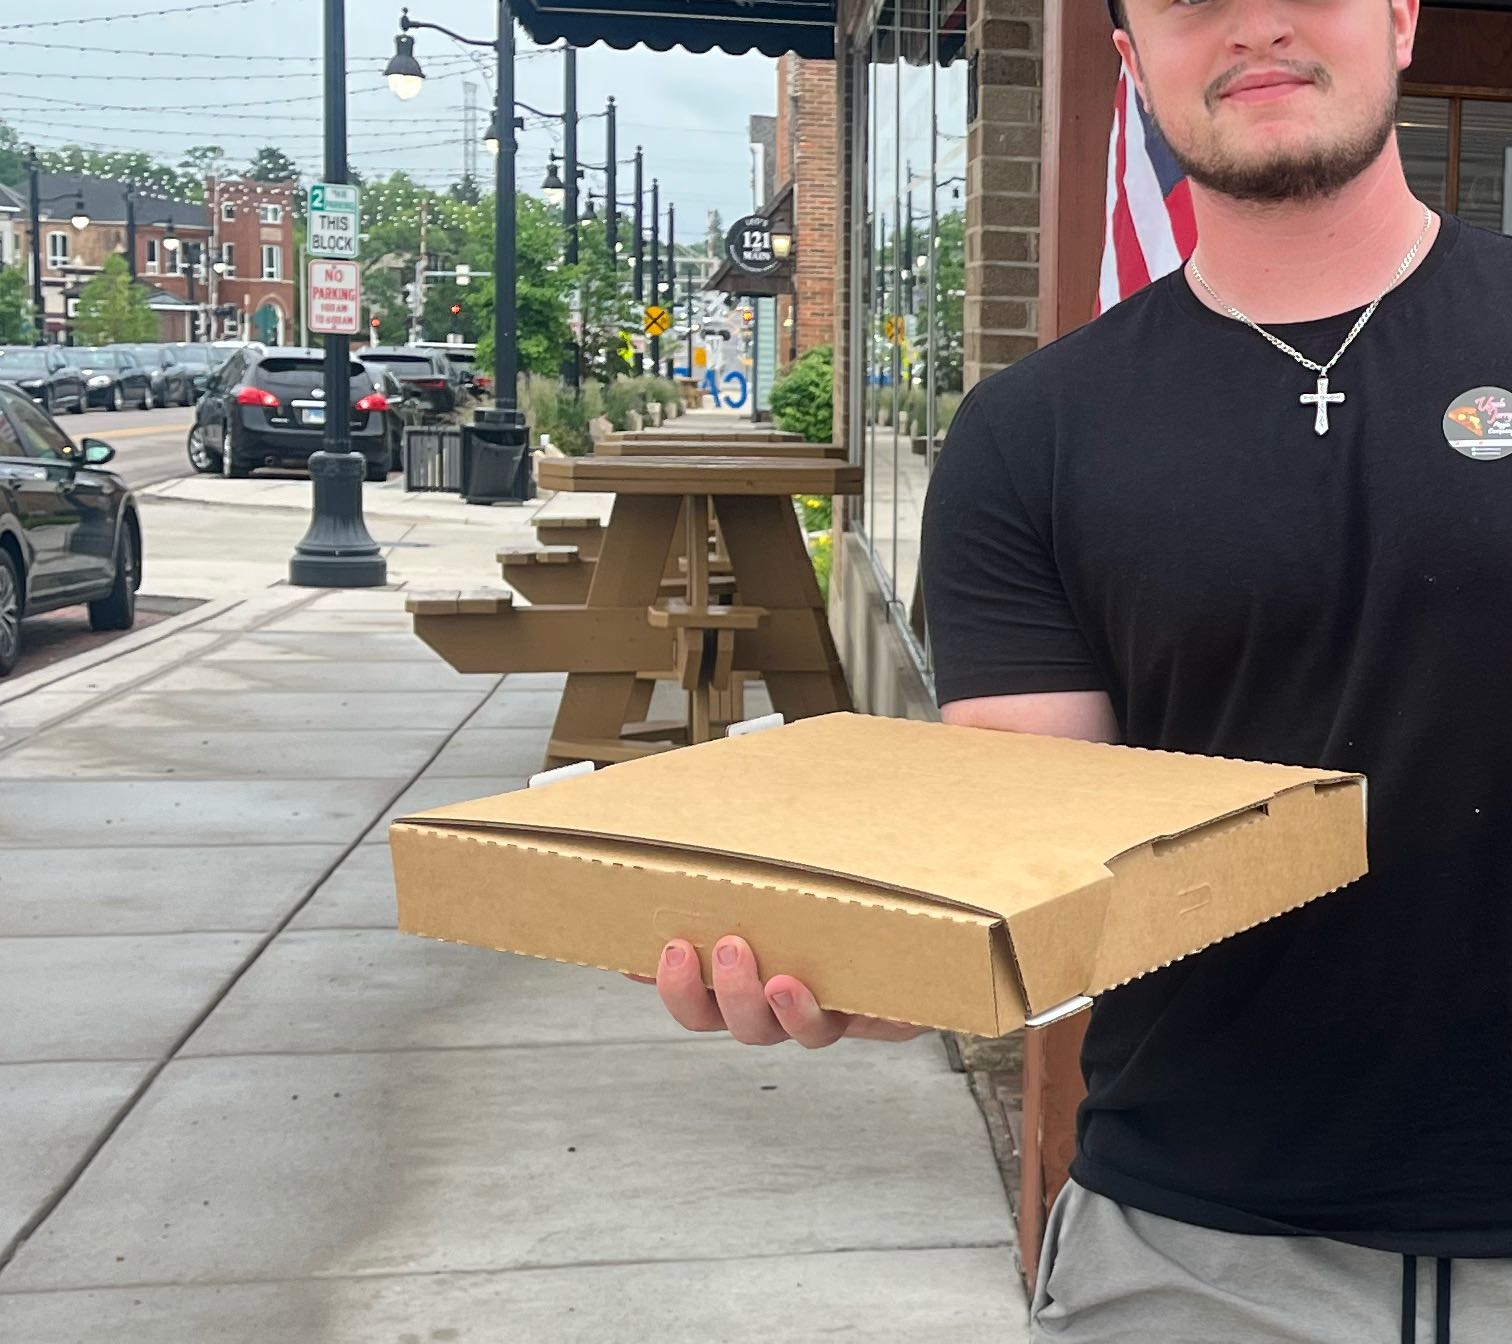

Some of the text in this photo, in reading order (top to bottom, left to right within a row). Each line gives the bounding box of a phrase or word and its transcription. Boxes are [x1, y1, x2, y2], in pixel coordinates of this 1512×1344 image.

[312, 189, 324, 208] 2
[319, 215, 349, 231] THIS
[312, 234, 353, 252] BLOCK
[743, 231, 770, 249] 121
[324, 270, 344, 282] NO
[312, 287, 356, 301] PARKING
